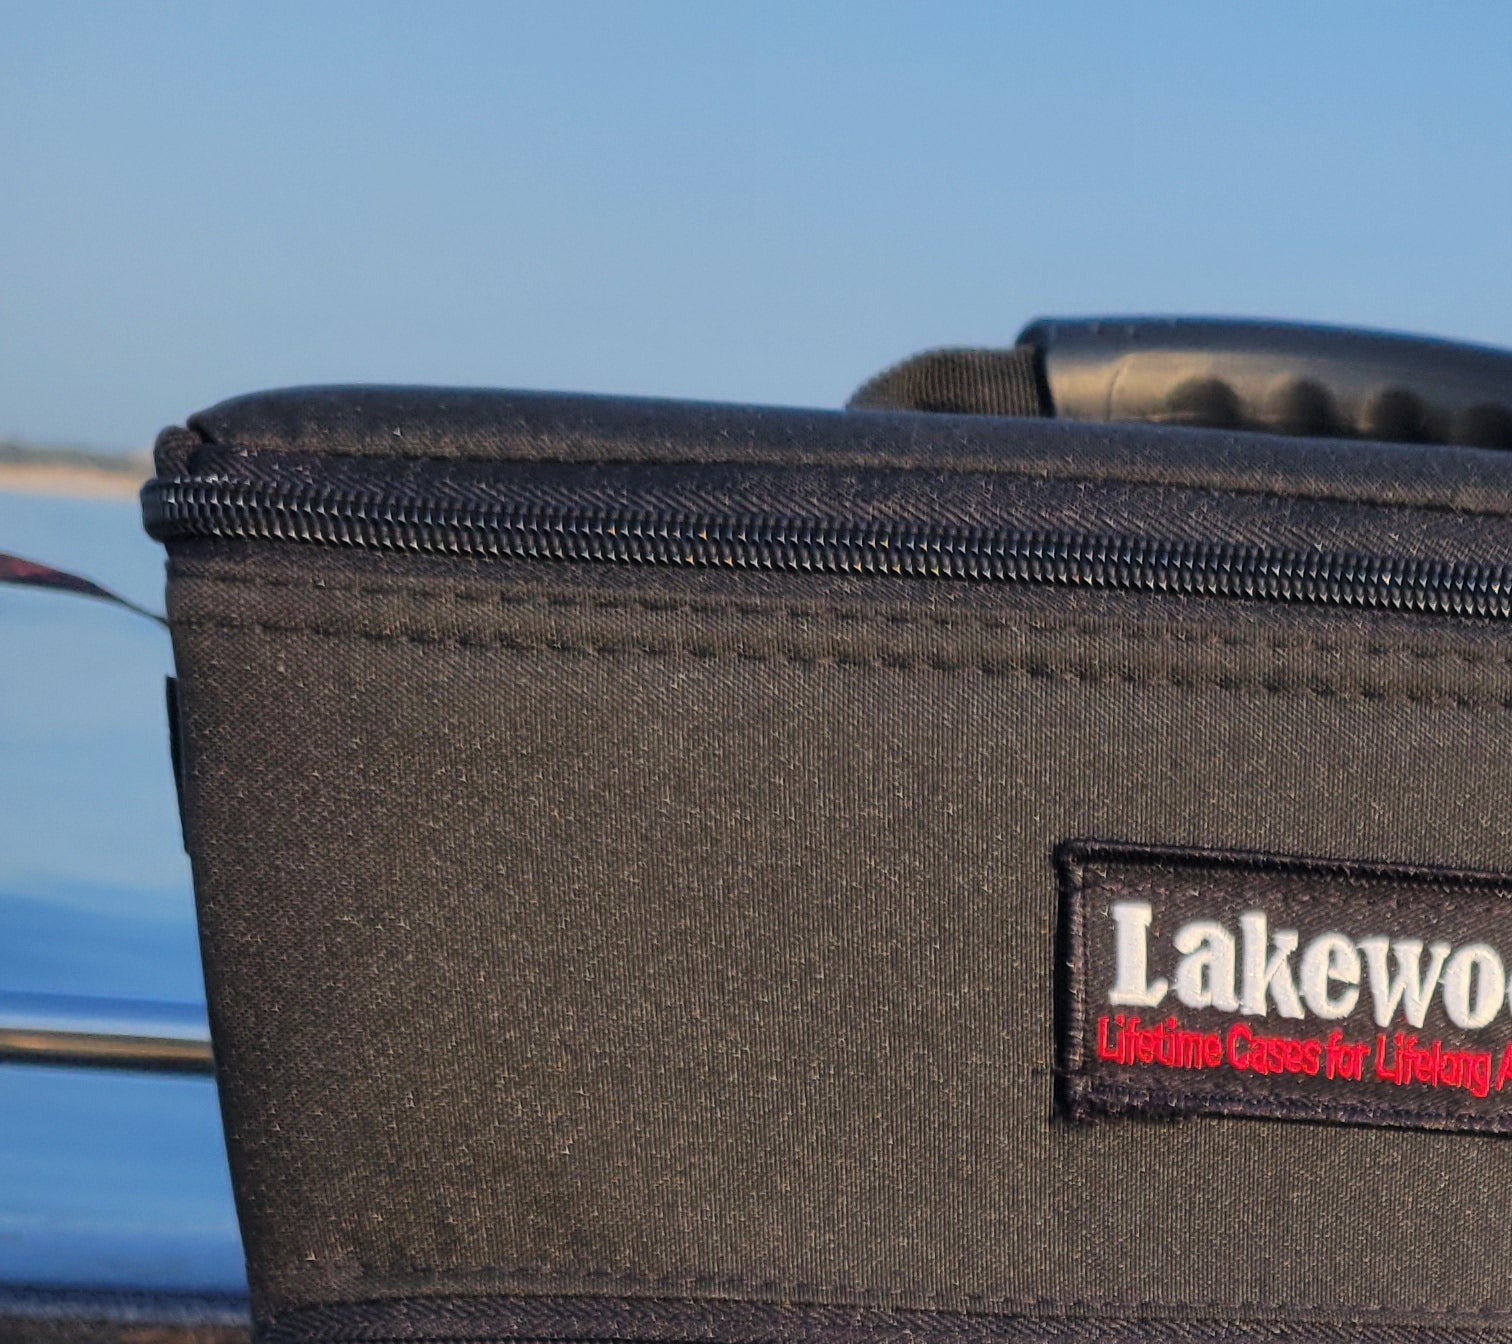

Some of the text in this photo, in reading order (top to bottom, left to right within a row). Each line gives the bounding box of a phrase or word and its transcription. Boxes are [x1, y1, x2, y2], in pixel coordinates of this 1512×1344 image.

[1097, 1013, 1223, 1070] Lifetime
[1225, 1021, 1322, 1076] Cases
[1325, 1028, 1371, 1081] for
[1374, 1032, 1493, 1099] Lifelong
